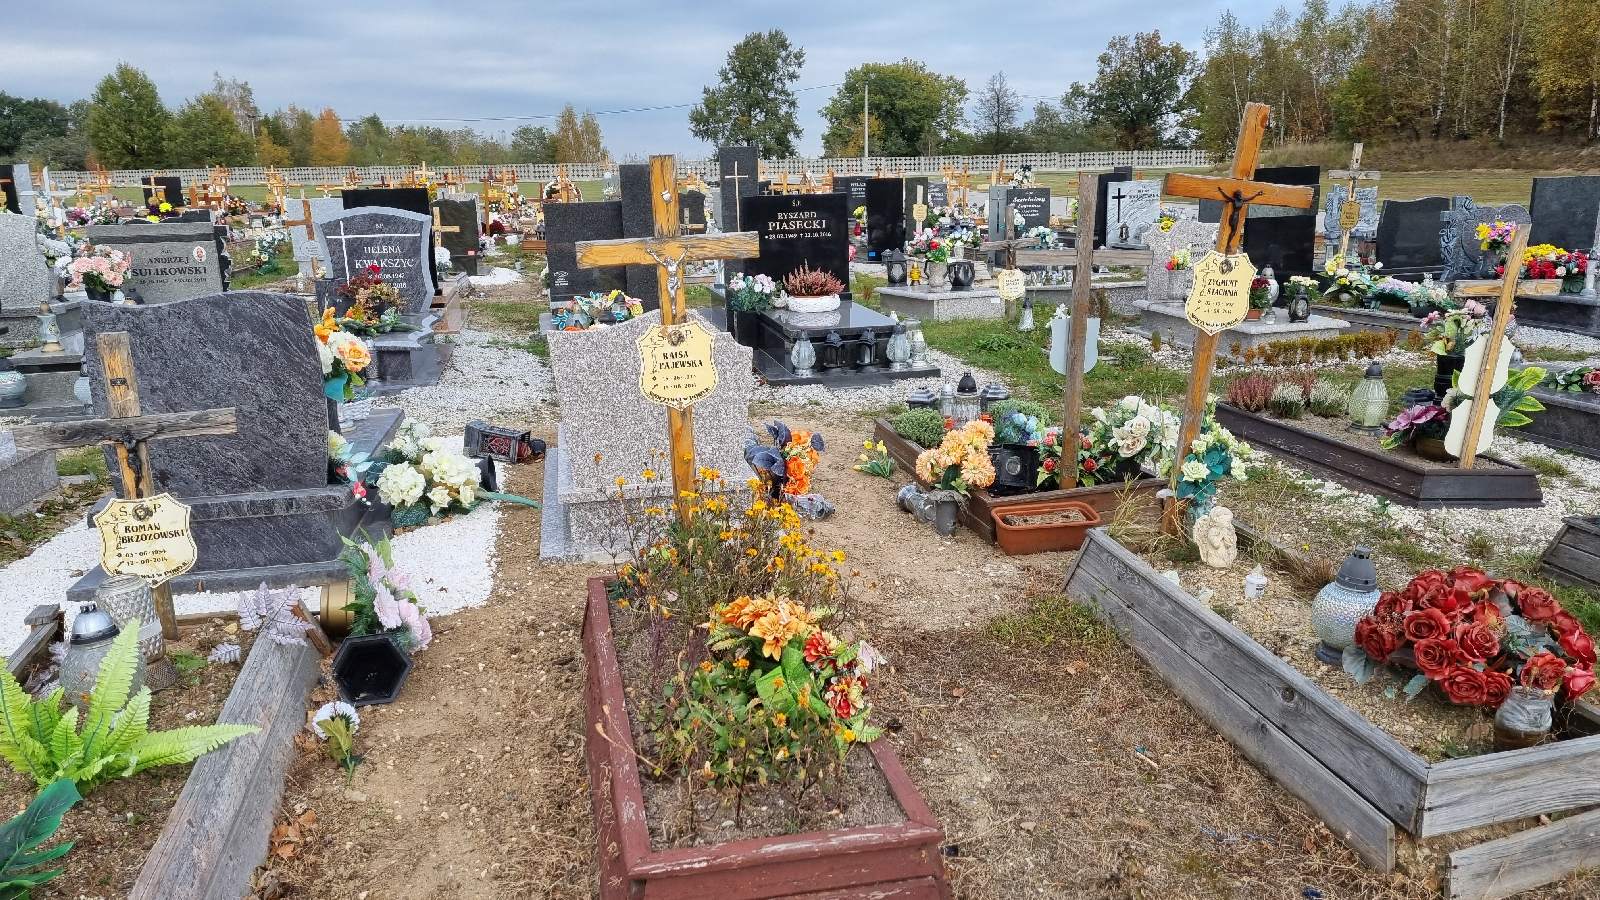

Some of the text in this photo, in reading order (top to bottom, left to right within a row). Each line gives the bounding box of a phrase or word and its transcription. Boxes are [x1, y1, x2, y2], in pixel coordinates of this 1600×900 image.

[777, 211, 817, 220] RYSZARD
[768, 220, 826, 231] PIASECKI
[147, 256, 190, 265] ANDRZEJ
[132, 266, 207, 277] SULIKOWSKI
[1207, 279, 1239, 287] ZYGMUNT
[1207, 288, 1238, 297] STACHNIK
[662, 350, 689, 360] RAISA
[124, 522, 161, 534] ROMAN
[121, 529, 185, 544] BRZOZOWSKI
